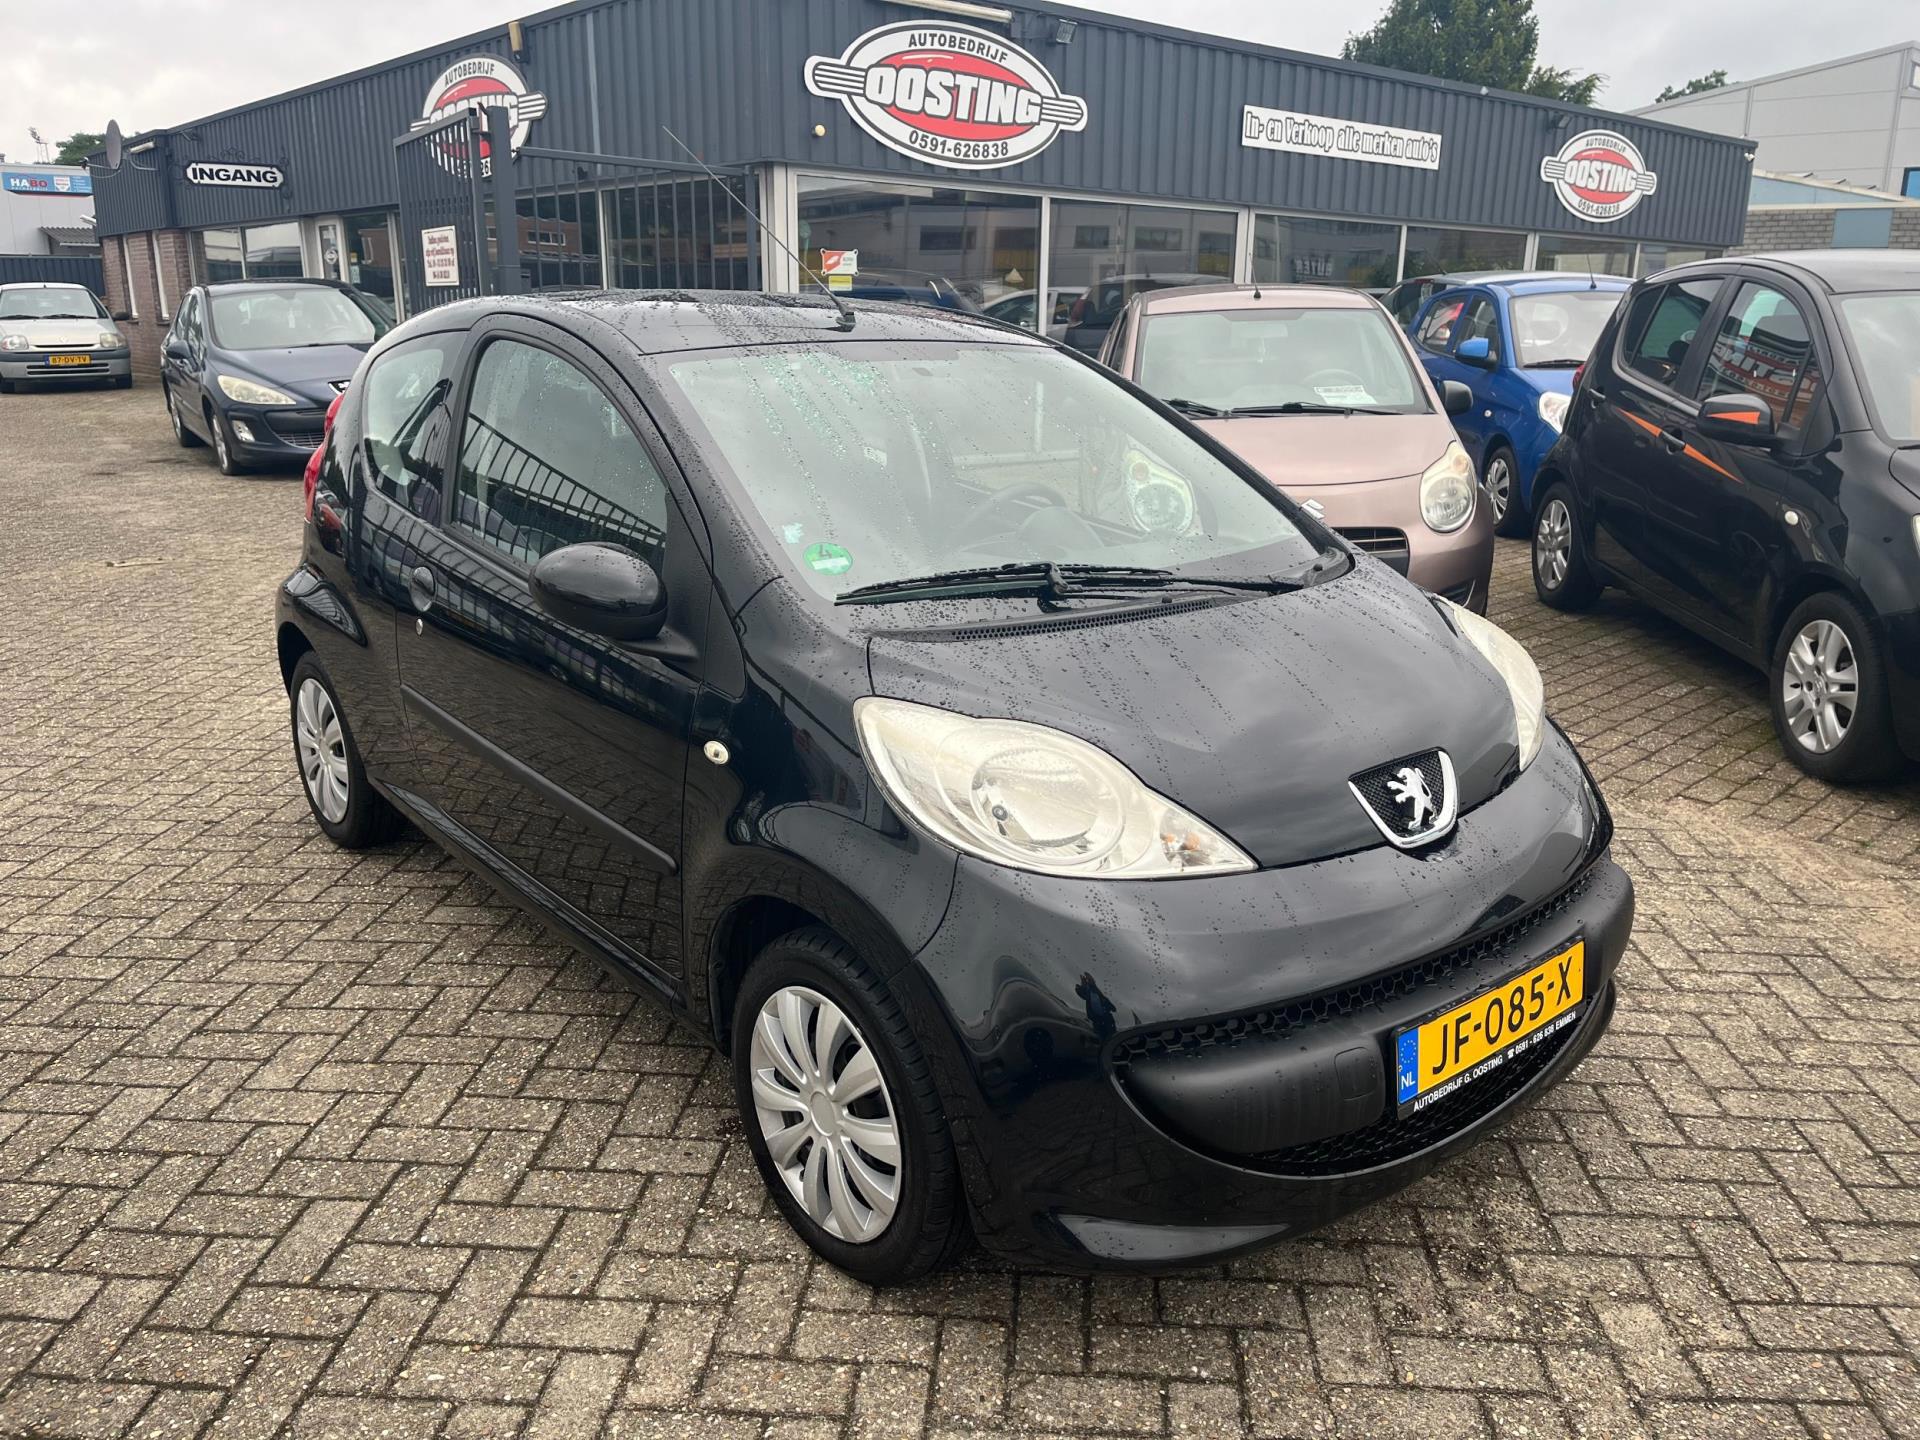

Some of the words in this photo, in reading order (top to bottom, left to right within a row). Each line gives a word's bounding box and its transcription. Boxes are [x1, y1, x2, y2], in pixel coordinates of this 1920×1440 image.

[908, 33, 1009, 64] AUTOBEDRIJF
[444, 61, 495, 87] AUTOBEDRIJF
[864, 64, 1043, 126] OOSTING
[909, 130, 1009, 159] 0591-626838
[1245, 111, 1264, 139] In-
[1266, 118, 1282, 142] en
[1285, 117, 1334, 152] Verkoop
[1337, 125, 1360, 152] alle
[1361, 131, 1403, 158] merken
[1405, 136, 1438, 163] auto's
[1586, 137, 1626, 153] AUTOBEDRIJF
[10, 177, 48, 187] HABO
[191, 167, 278, 183] INGANG
[1564, 158, 1638, 193] OOSTING
[1432, 956, 1573, 1075] JF-085-X
[1413, 1076, 1463, 1112] AUTOBEDRIJF
[1463, 1072, 1472, 1084] G.
[1473, 1055, 1503, 1079] OOSTING
[1555, 1010, 1577, 1031] EMMEN
[1401, 1071, 1416, 1091] NL
